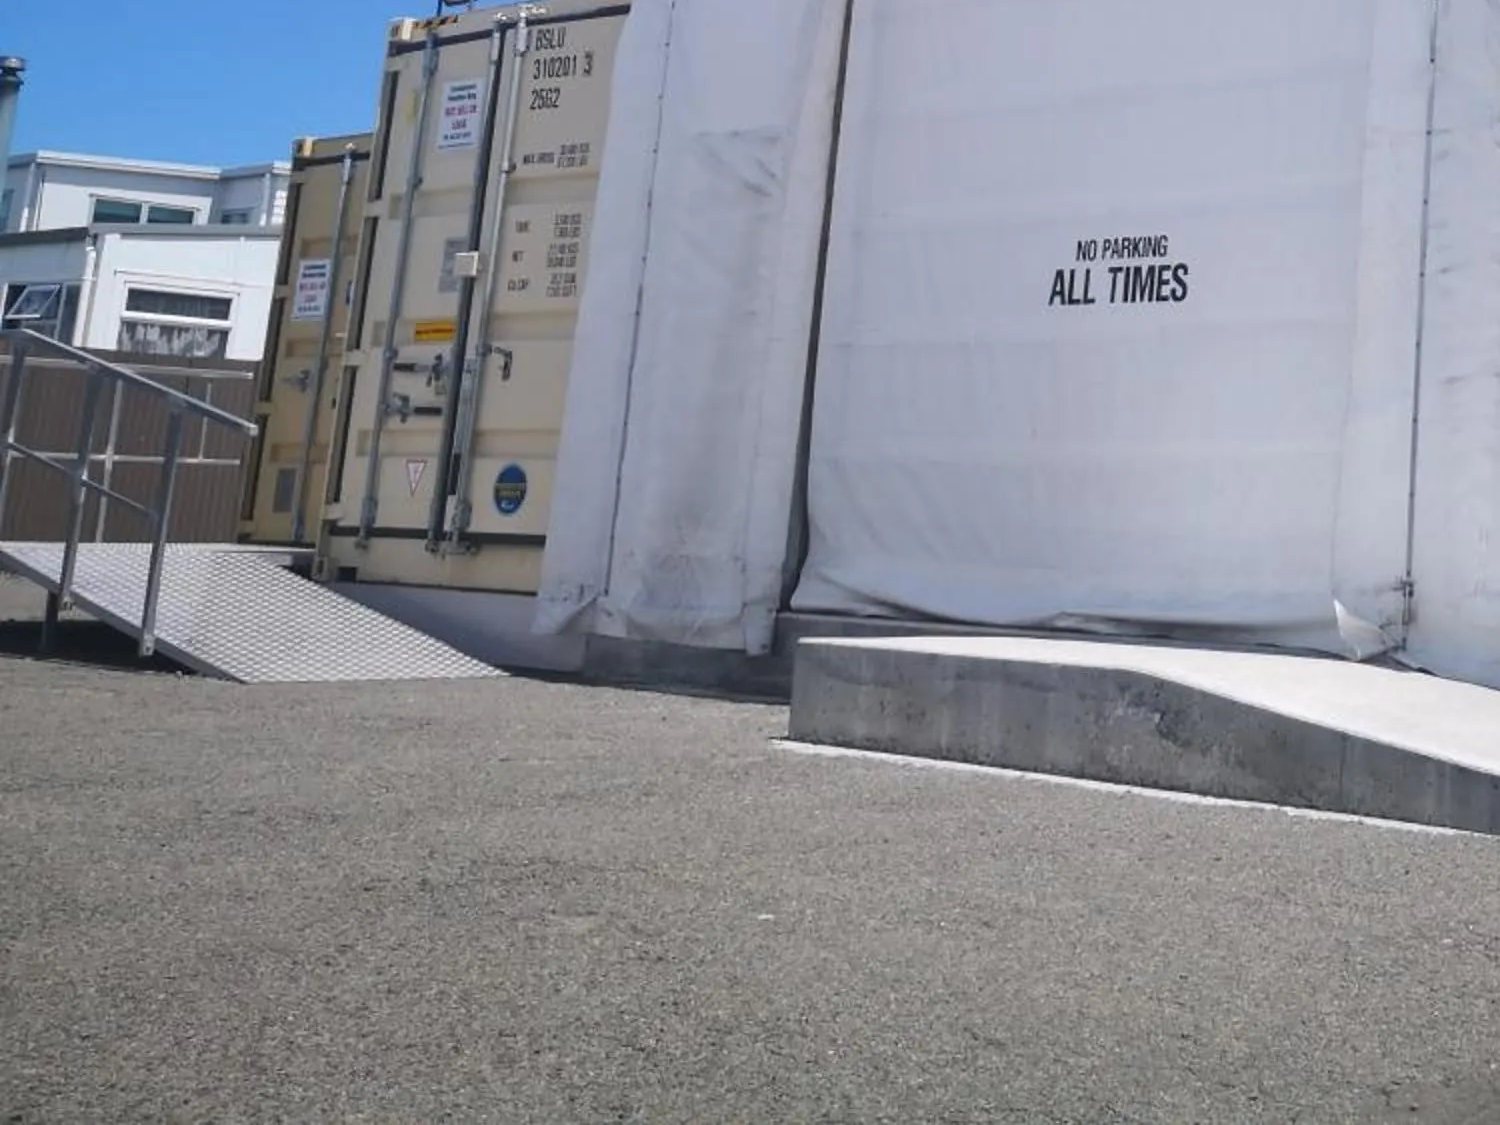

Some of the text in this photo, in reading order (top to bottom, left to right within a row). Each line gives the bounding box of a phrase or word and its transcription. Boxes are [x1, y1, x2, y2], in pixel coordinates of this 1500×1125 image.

[532, 54, 577, 81] 310201
[1076, 234, 1169, 262] NO PARKING
[1048, 262, 1190, 307] ALL TIMES
